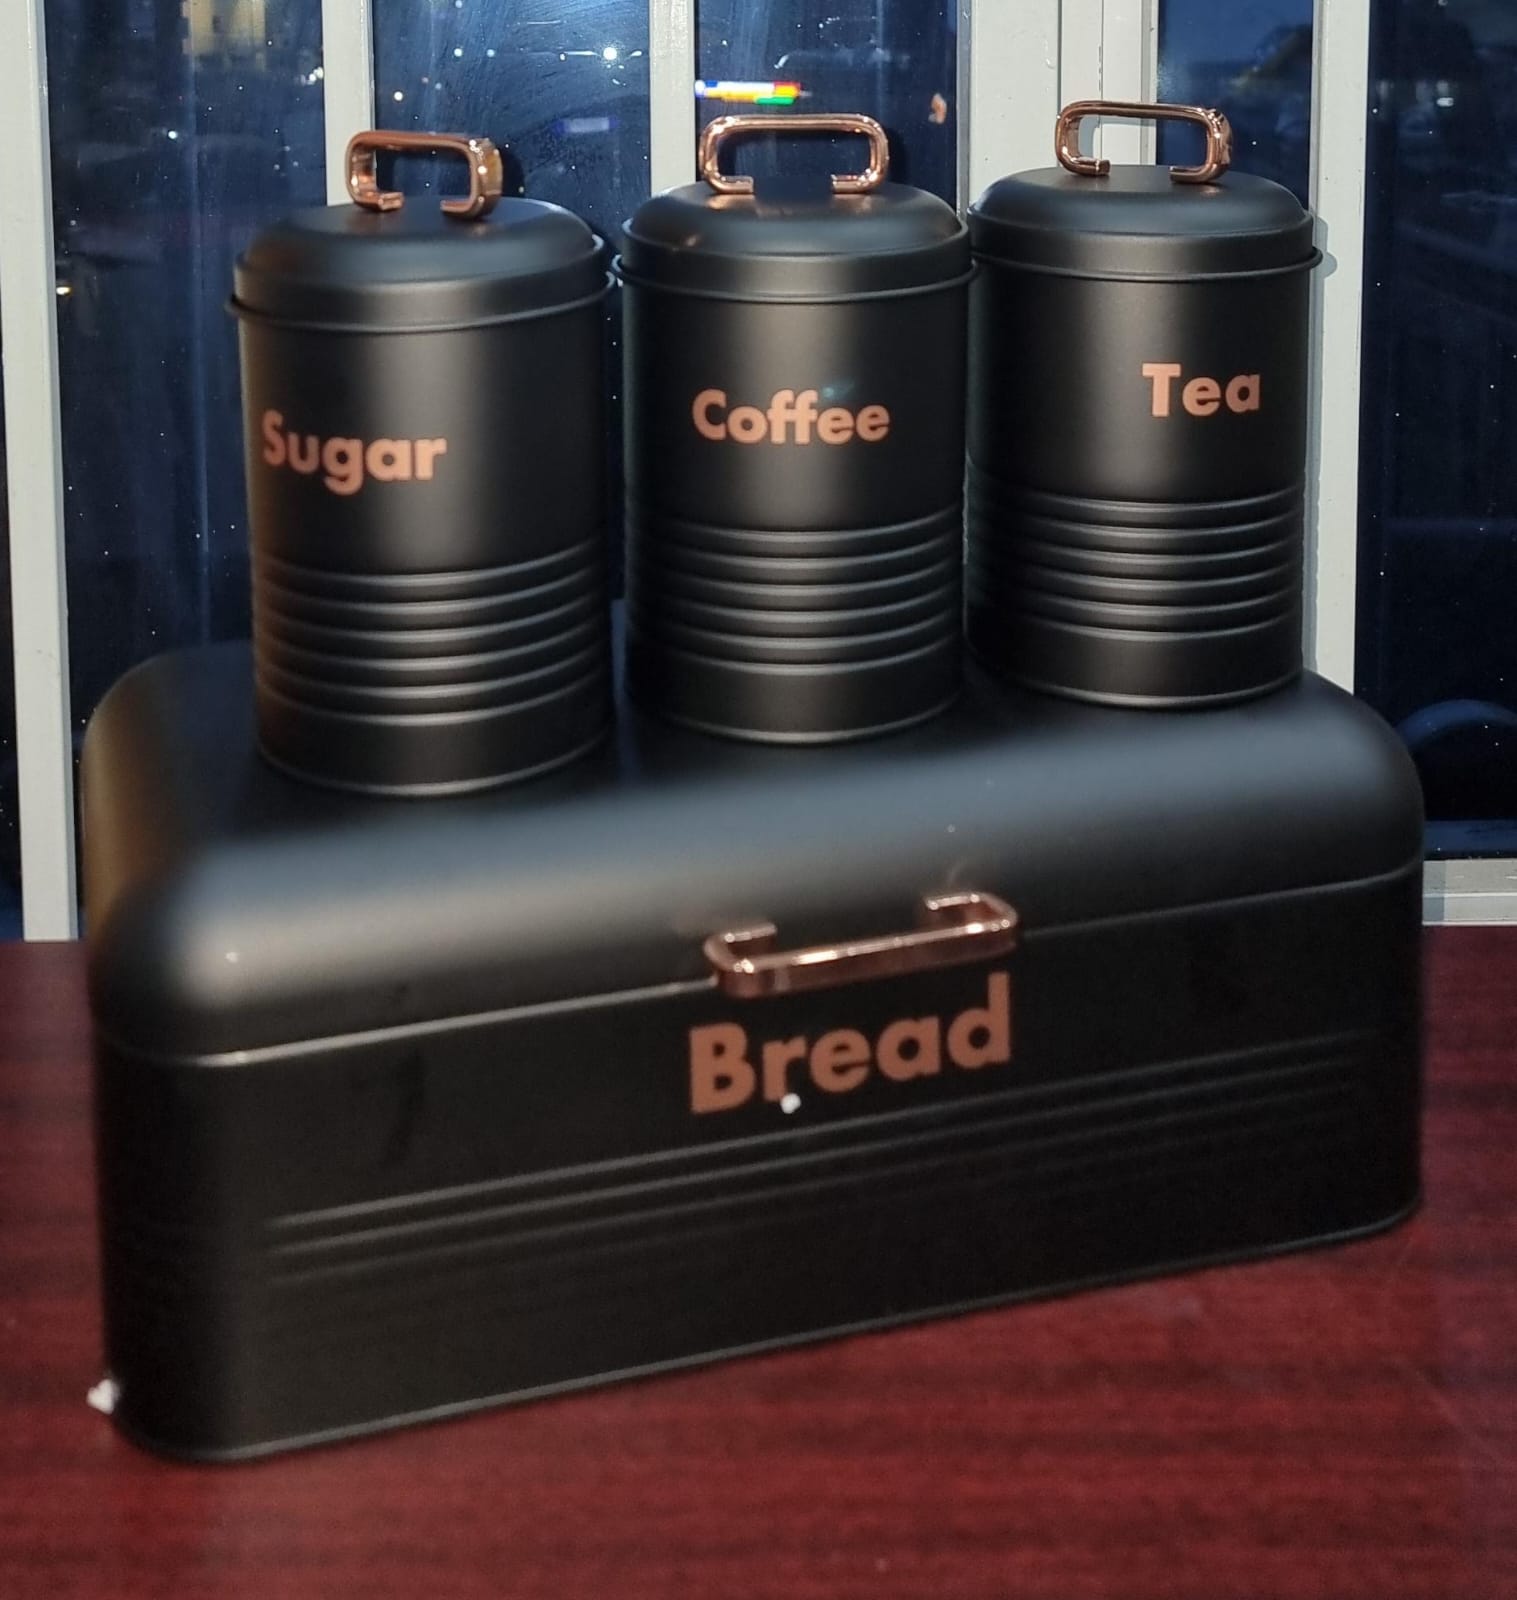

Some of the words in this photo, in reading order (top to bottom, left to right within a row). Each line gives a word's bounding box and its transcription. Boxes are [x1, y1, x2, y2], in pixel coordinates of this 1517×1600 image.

[692, 388, 891, 446] Coffee
[1142, 362, 1262, 418] Tea
[262, 409, 448, 496] Sugar
[690, 973, 1011, 1113] Bread
